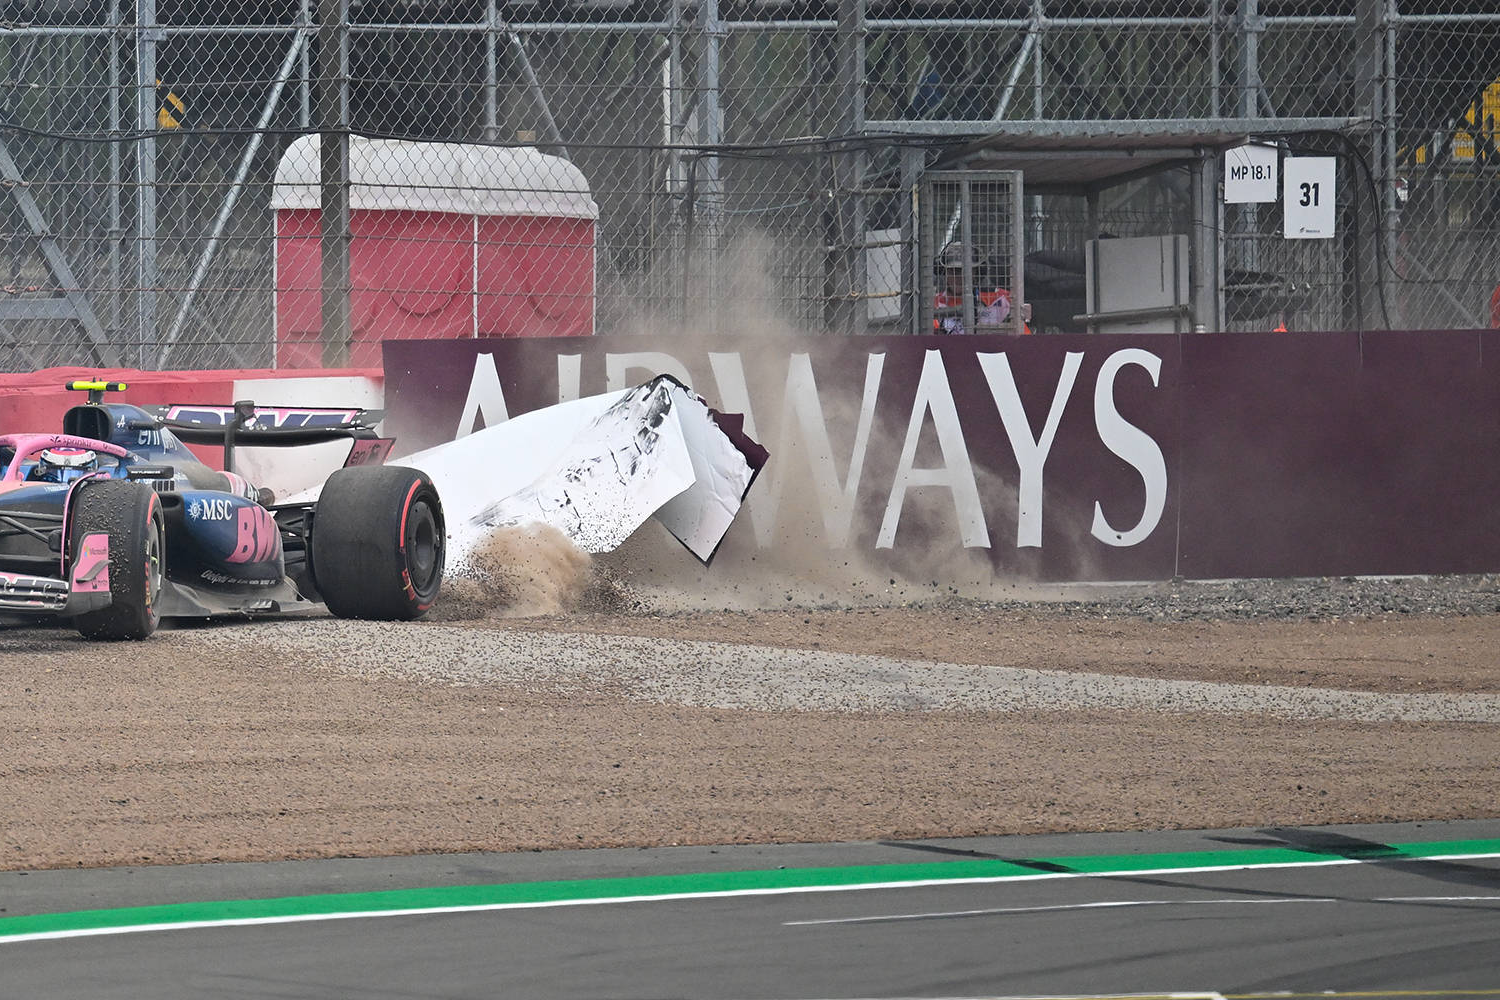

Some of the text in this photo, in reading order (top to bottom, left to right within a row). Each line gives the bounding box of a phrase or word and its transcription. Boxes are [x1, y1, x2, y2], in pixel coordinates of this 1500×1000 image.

[1231, 165, 1271, 180] MP 18.1
[1300, 183, 1319, 207] 31
[201, 499, 233, 521] MSC
[225, 506, 282, 563] BW
